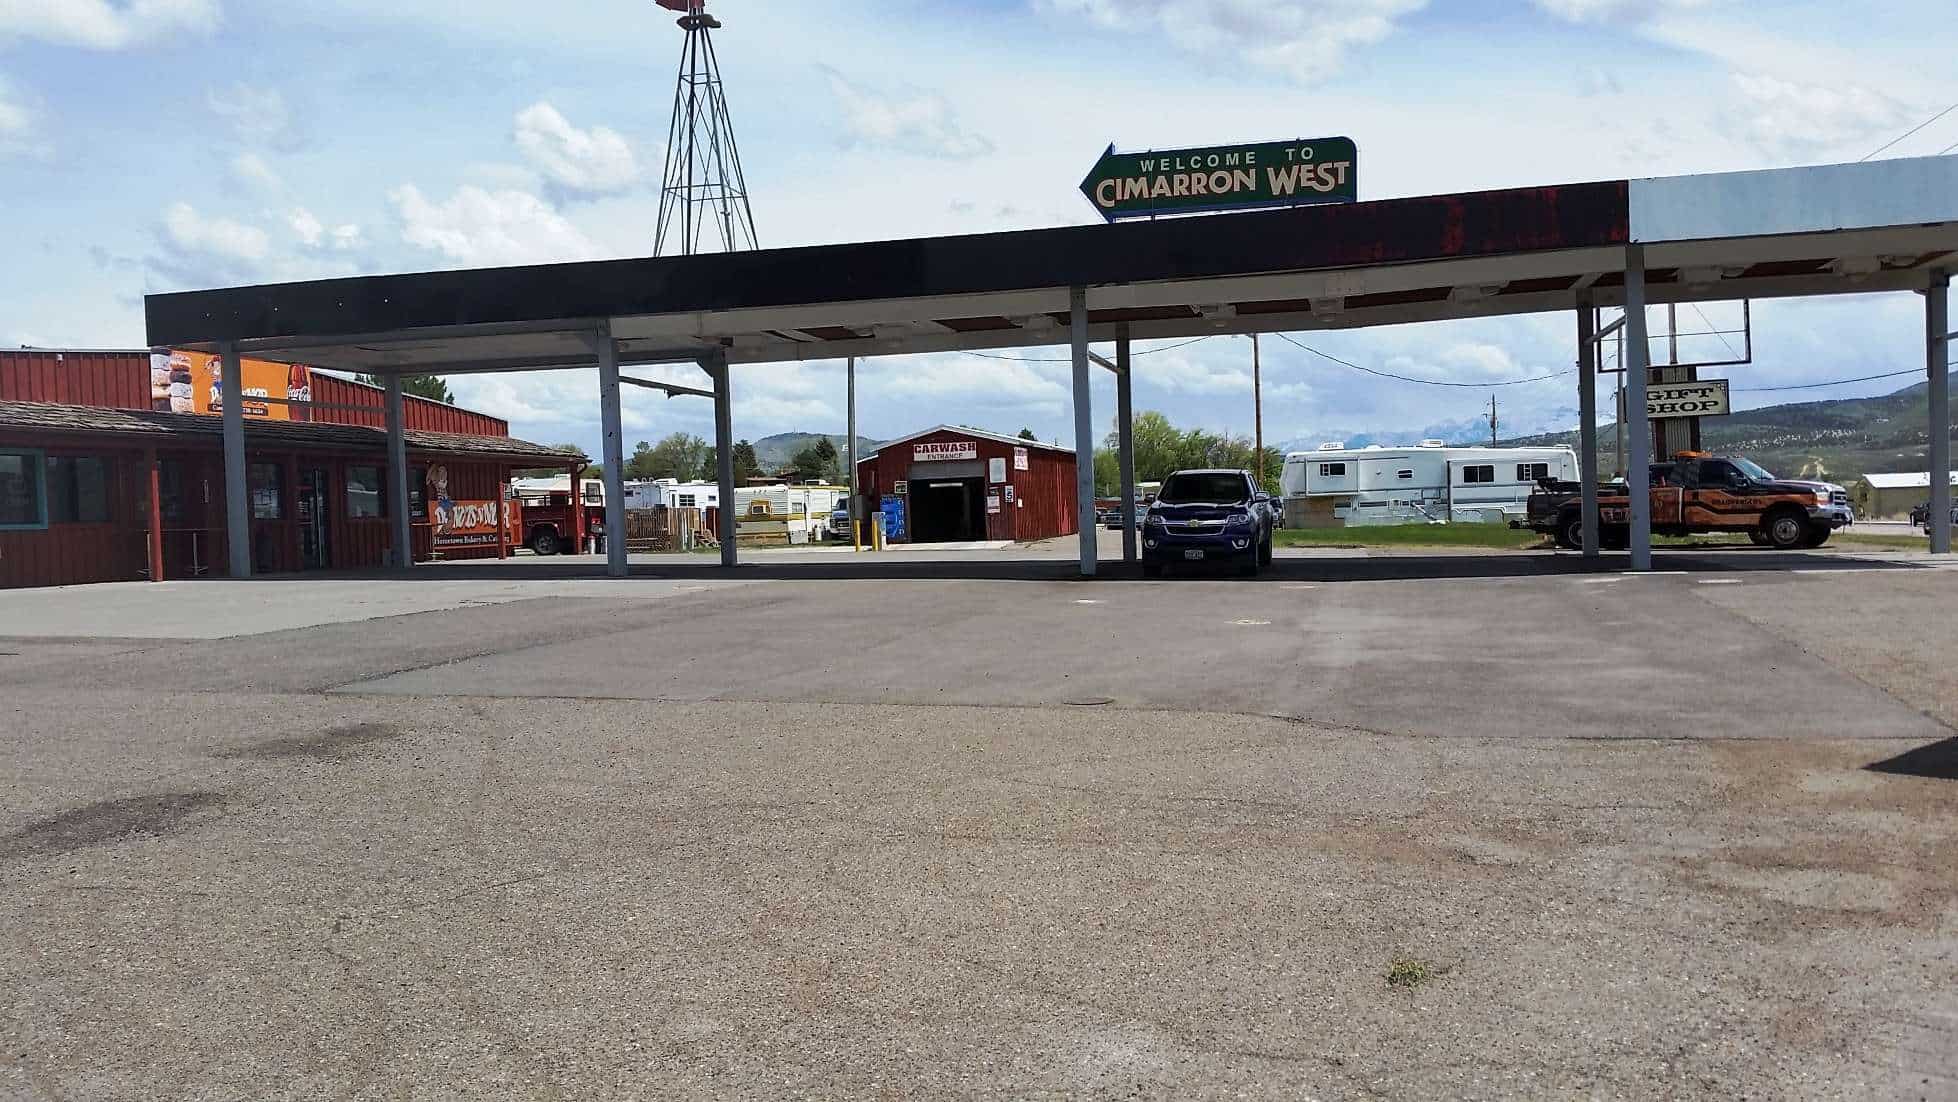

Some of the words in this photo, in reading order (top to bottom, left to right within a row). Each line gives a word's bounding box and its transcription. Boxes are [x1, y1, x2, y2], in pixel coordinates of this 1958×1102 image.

[1140, 151, 1256, 172] WELCOME
[1285, 147, 1314, 161] TO
[1096, 168, 1256, 208] CIMARRON
[1267, 161, 1350, 196] WEST
[1647, 388, 1714, 401] GIFT
[1647, 400, 1719, 414] SHOP
[914, 443, 976, 454] CARWASH
[927, 452, 964, 460] ENTRANCE
